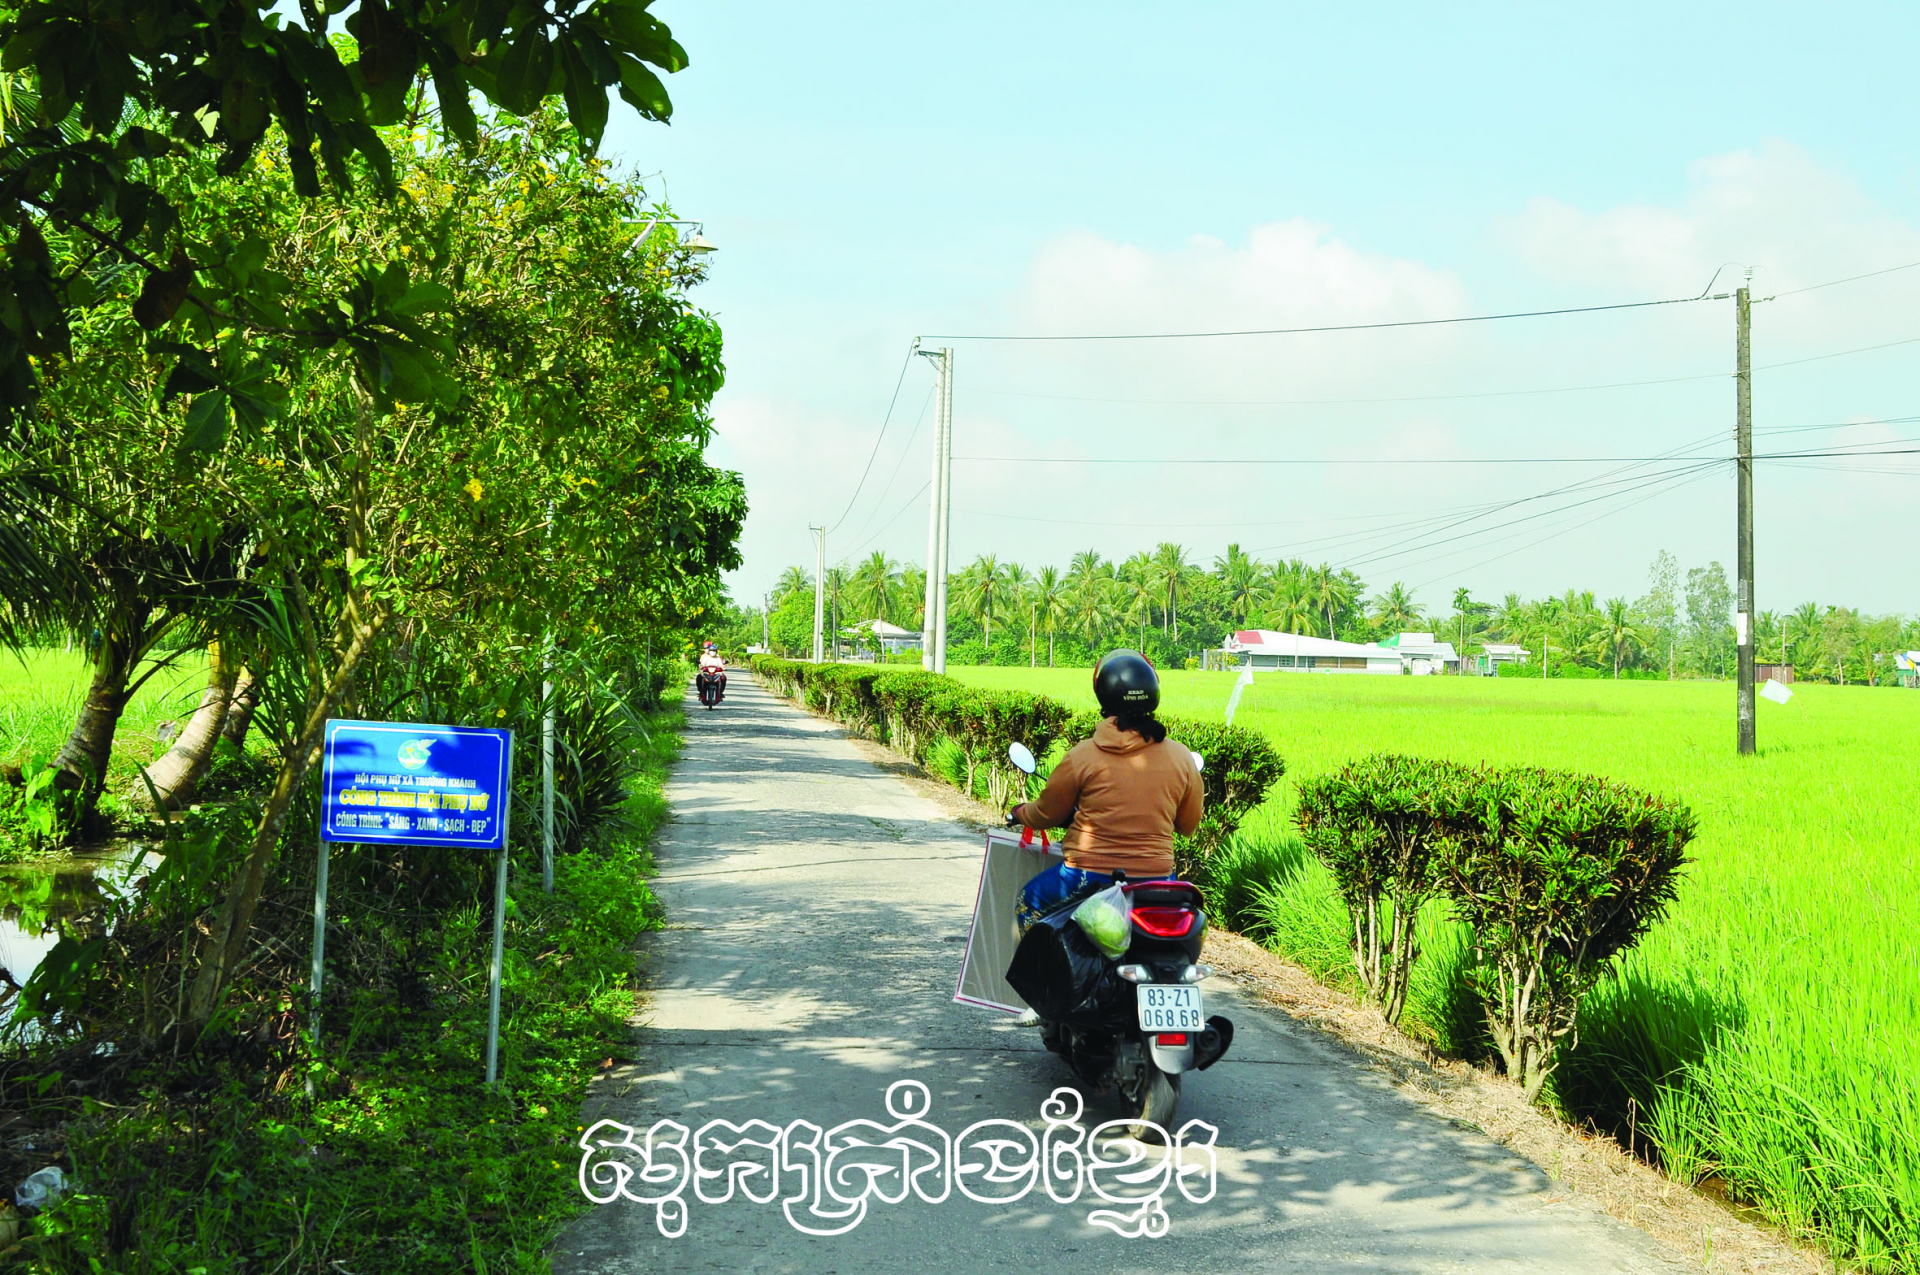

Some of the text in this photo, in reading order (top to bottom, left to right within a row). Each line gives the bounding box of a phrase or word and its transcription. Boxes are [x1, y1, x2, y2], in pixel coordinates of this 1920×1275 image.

[355, 773, 476, 788] HỘI PHỤ NỮ XÃ TRƯỜNG KHÁNH
[339, 786, 489, 813] CÔNG TRÌNH HỘI PHỤ NỮ
[336, 811, 357, 827] CÔNG
[358, 813, 383, 828] TRÌNH:
[416, 817, 438, 831] XANH
[444, 819, 465, 834] SẠCH
[1148, 989, 1190, 1006] 83-Z1
[1144, 1009, 1199, 1027] 068.68
